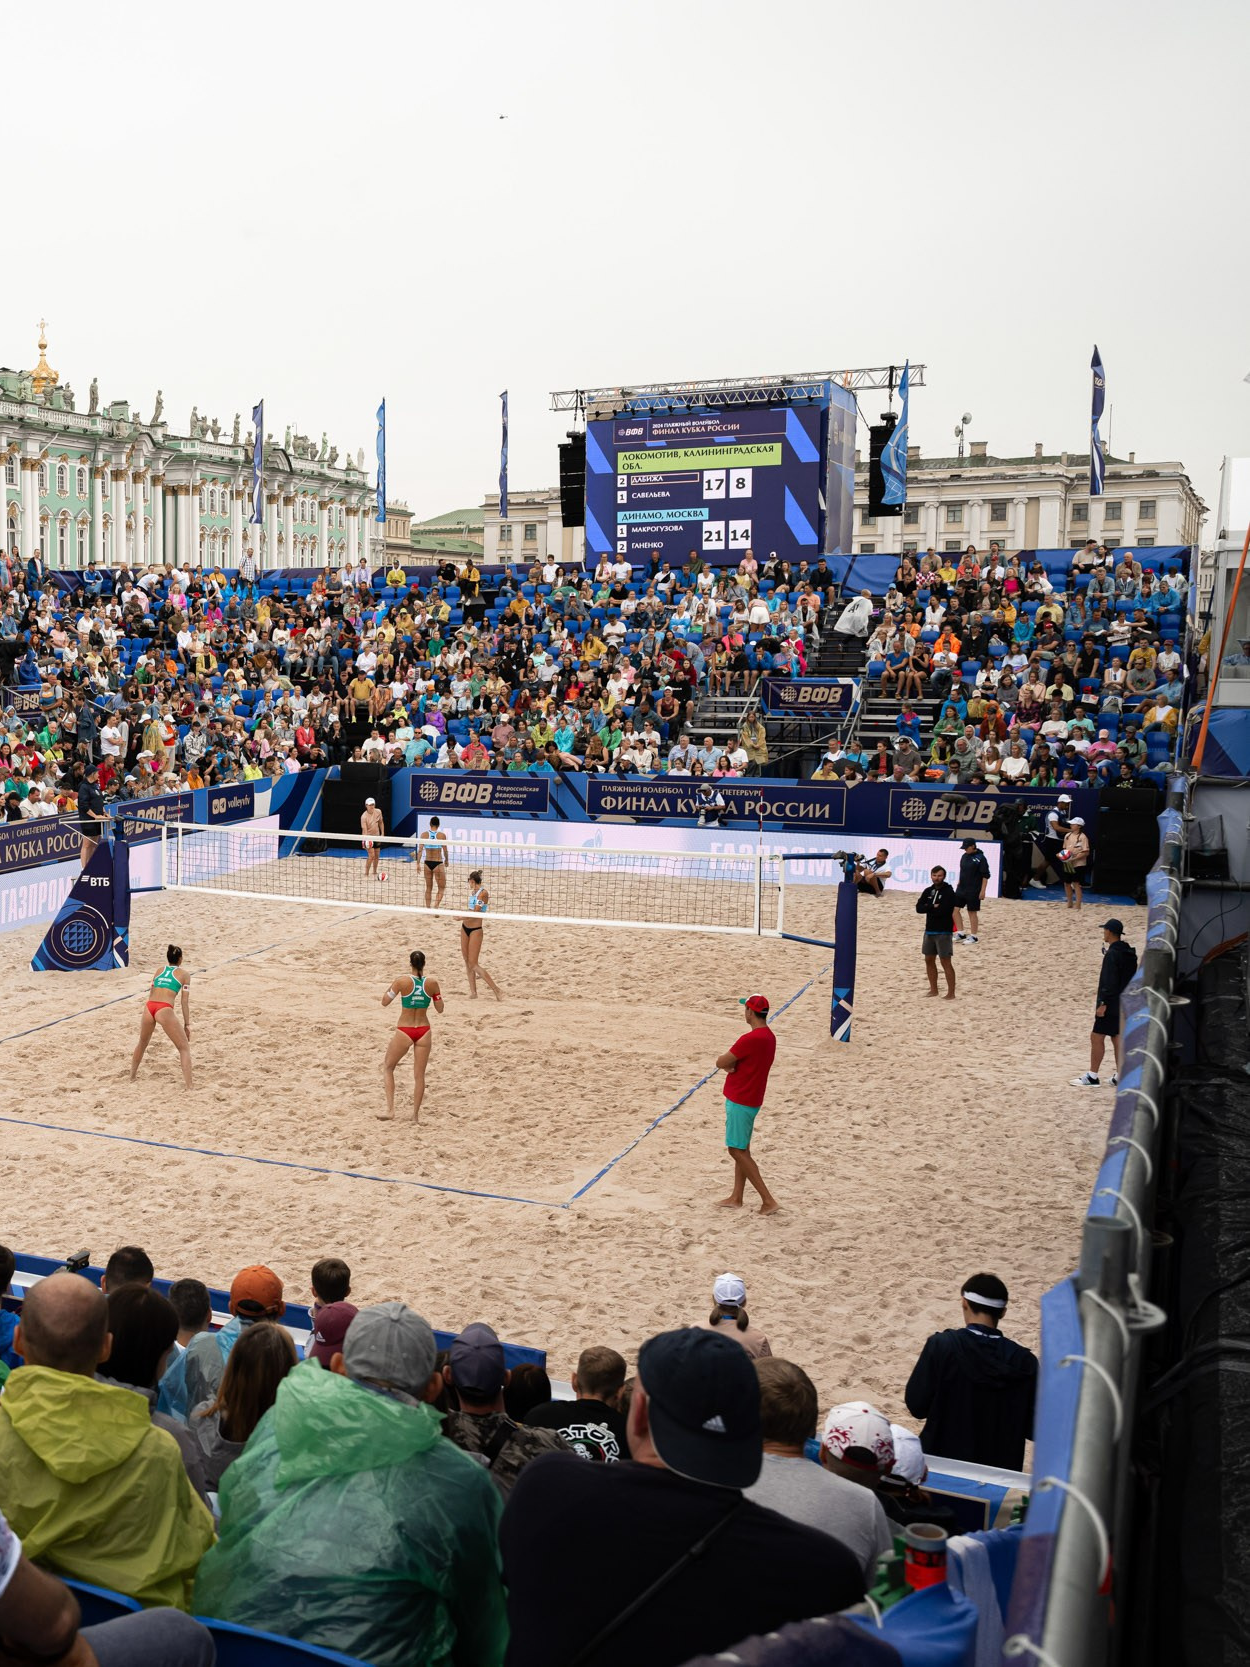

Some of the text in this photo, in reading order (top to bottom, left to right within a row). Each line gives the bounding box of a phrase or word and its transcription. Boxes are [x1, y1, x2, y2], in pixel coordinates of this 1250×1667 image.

[625, 428, 643, 436] ВФВ
[681, 426, 705, 434] КУБКА
[708, 424, 739, 432] РОССИИ
[622, 445, 774, 460] ЛОКОМОТИВ, КАЛИНИНГРАДСКАЯ
[622, 462, 642, 470] ОБЛ.
[705, 477, 746, 491] 17 8
[622, 510, 704, 521] ДИНАМО, МОСКВА
[704, 529, 750, 542] 21 14
[798, 687, 843, 703] ВФВ
[439, 782, 493, 804] ВФВ
[497, 785, 539, 793] Всероссийская
[601, 785, 641, 793] ПЛЯЖНЫЙ
[643, 786, 683, 794] ВОЛЕЙБОЛ
[600, 796, 670, 813] ФИНАЛ
[744, 800, 830, 818] РОССИИ
[927, 798, 998, 824] ВФВ
[16, 823, 58, 837] САНКТ-ПЕТЕРБУРГ
[5, 838, 44, 862] КУБКА
[90, 877, 110, 886] ВТБ
[414, 985, 422, 995] 2
